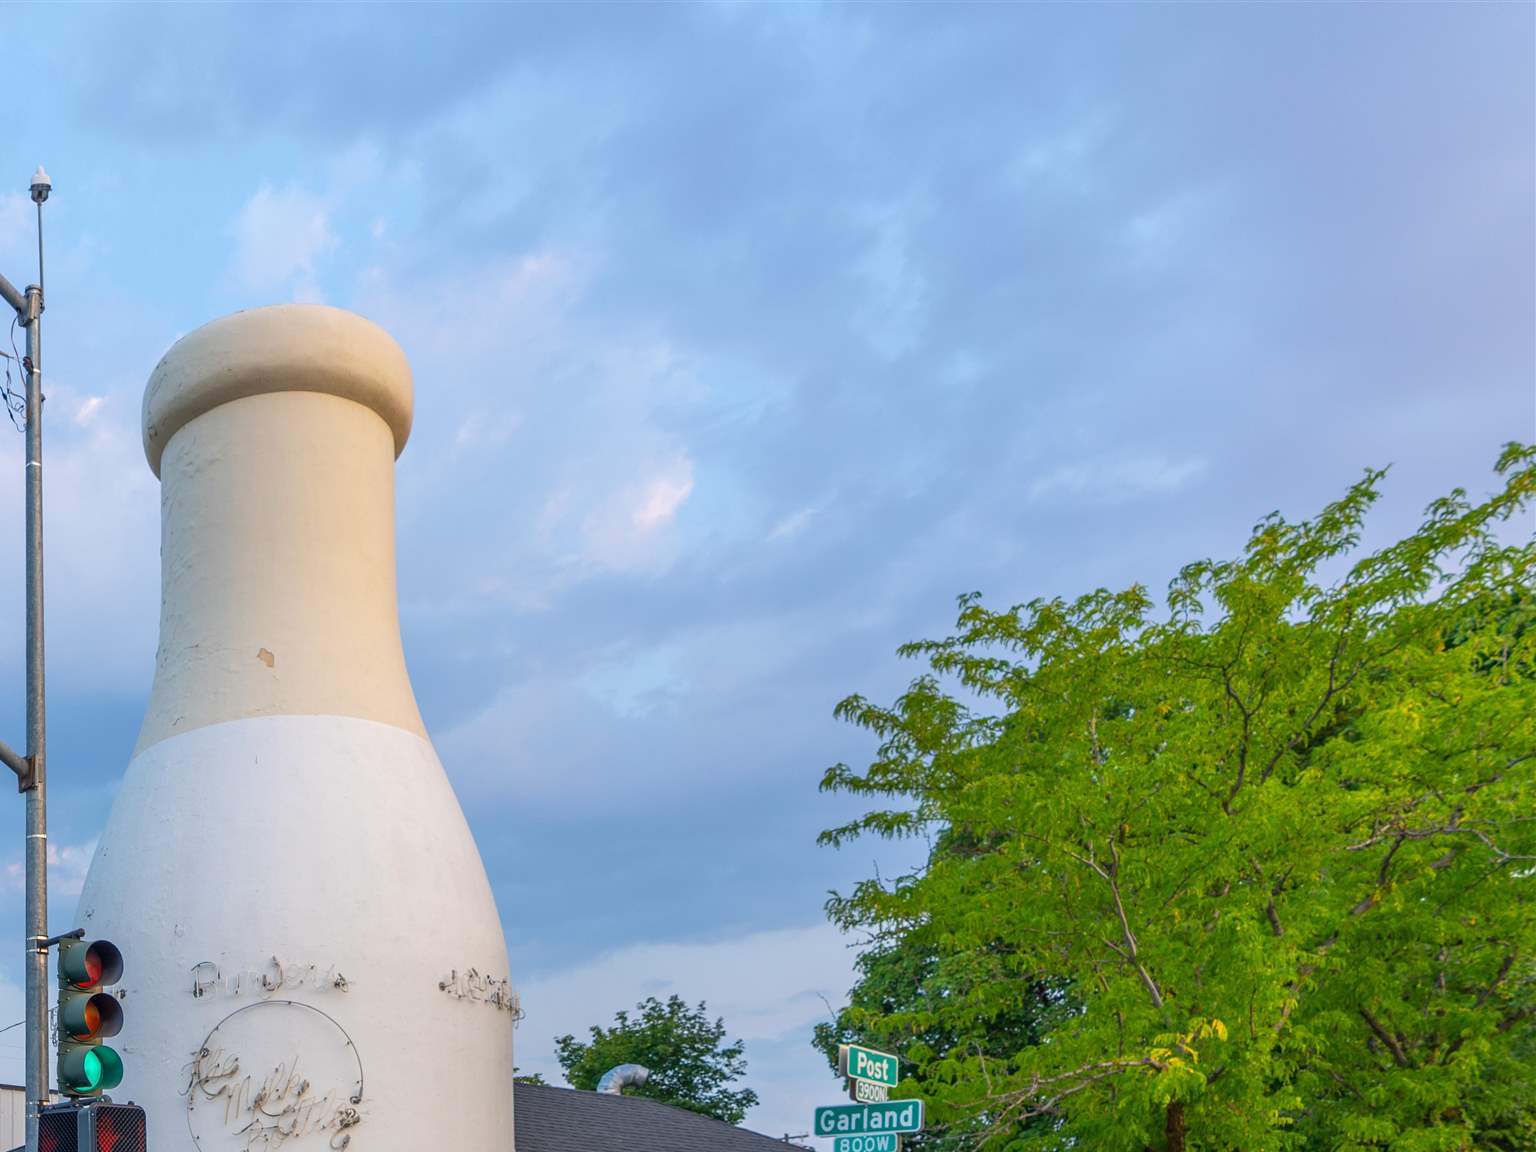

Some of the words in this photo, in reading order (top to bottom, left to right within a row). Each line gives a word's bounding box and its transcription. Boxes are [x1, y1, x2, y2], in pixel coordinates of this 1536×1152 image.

[857, 1051, 889, 1081] Post
[857, 1082, 885, 1102] 3900N
[820, 1104, 913, 1132] Garland
